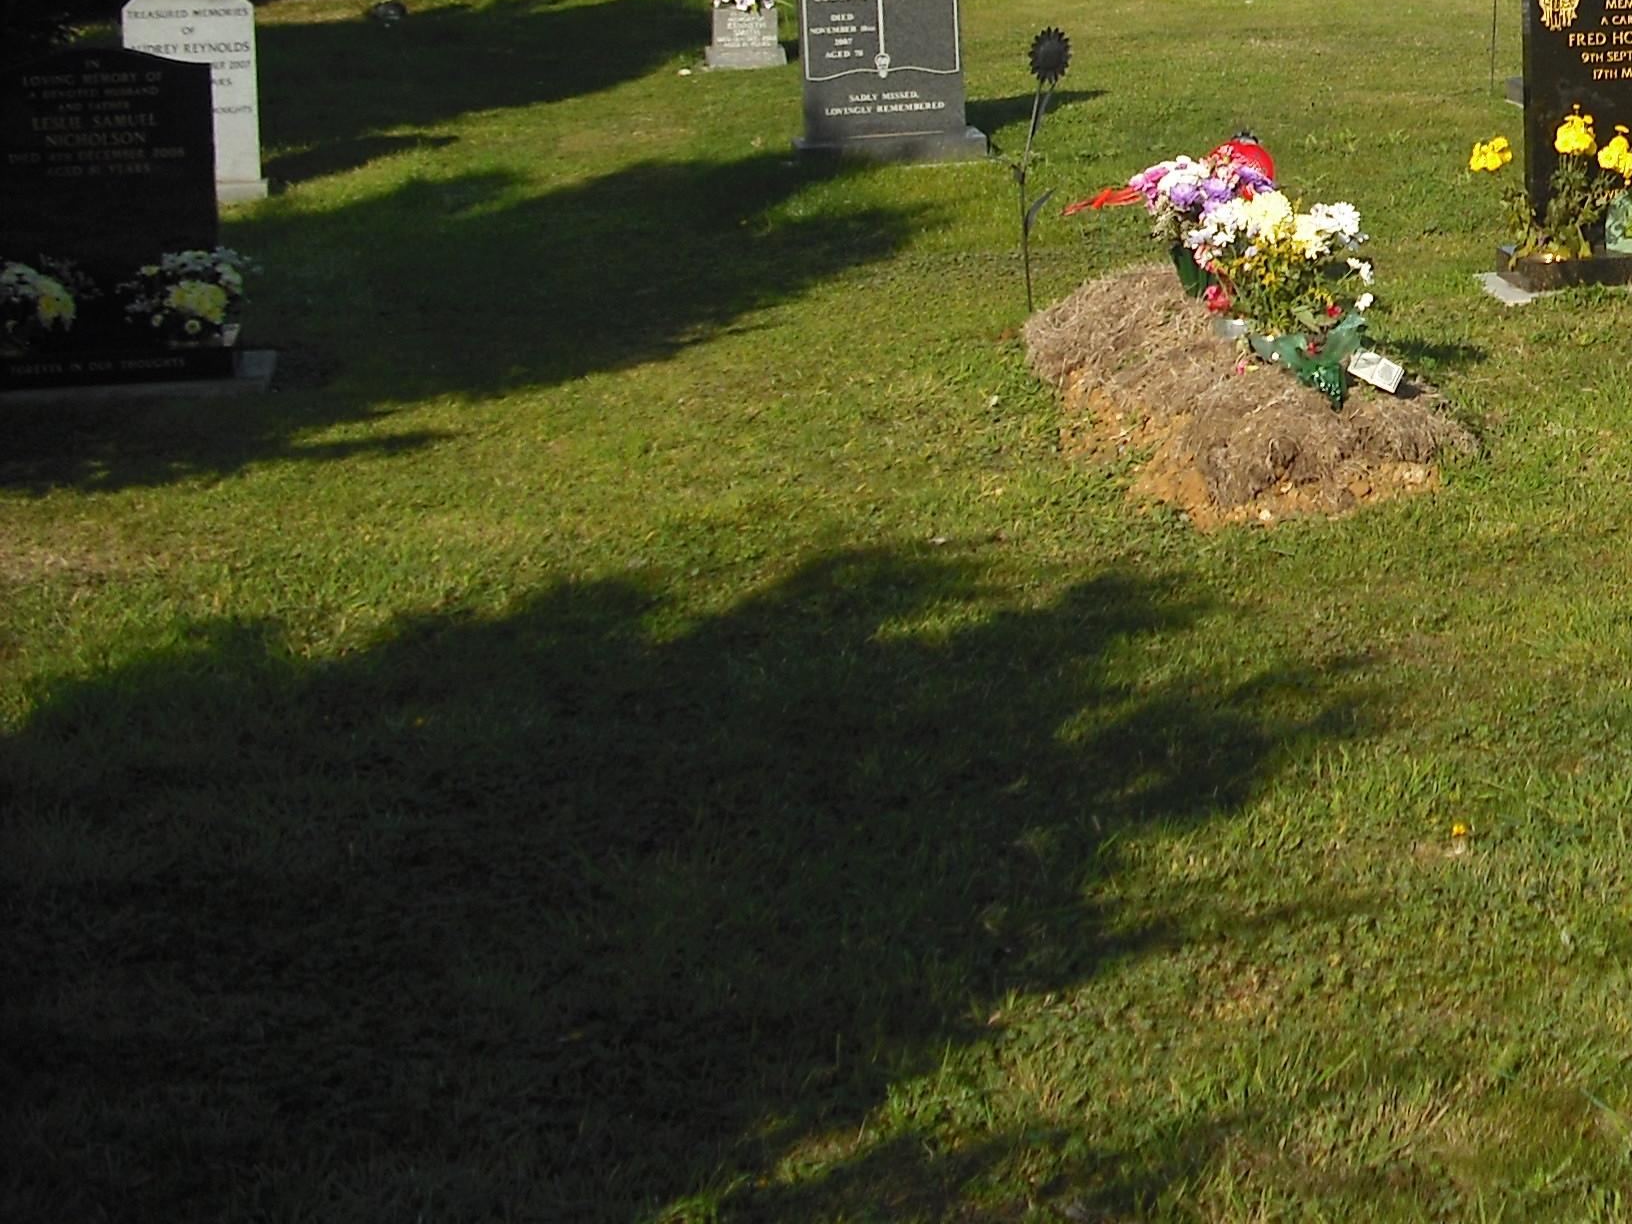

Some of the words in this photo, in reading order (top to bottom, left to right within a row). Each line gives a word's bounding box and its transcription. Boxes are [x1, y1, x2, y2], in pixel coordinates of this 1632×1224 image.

[127, 10, 188, 19] TREASURED
[192, 8, 249, 17] MEMORIES
[830, 13, 855, 22] DIED
[1600, 15, 1609, 26] A
[181, 26, 195, 35] OF
[809, 25, 857, 34] NOVEMBER
[1568, 32, 1606, 47] FRED
[183, 41, 251, 54] REYNOLDS
[824, 51, 851, 59] AGED
[1581, 52, 1604, 63] 9TH
[22, 74, 77, 87] LOVING
[81, 71, 138, 85] MEMORY
[145, 71, 163, 82] OF
[1592, 68, 1618, 80] 17TH
[103, 86, 160, 97] HUSBAND
[848, 93, 878, 102] SADLY
[824, 106, 872, 116] LOVINGLY
[876, 101, 945, 113] REMEMBERED
[31, 116, 82, 131] LESLIE
[92, 112, 158, 128] SAMUEL
[45, 131, 146, 147] NICHOLSON
[77, 149, 145, 161] DECEMBER
[120, 357, 186, 369] THOUGHTS
